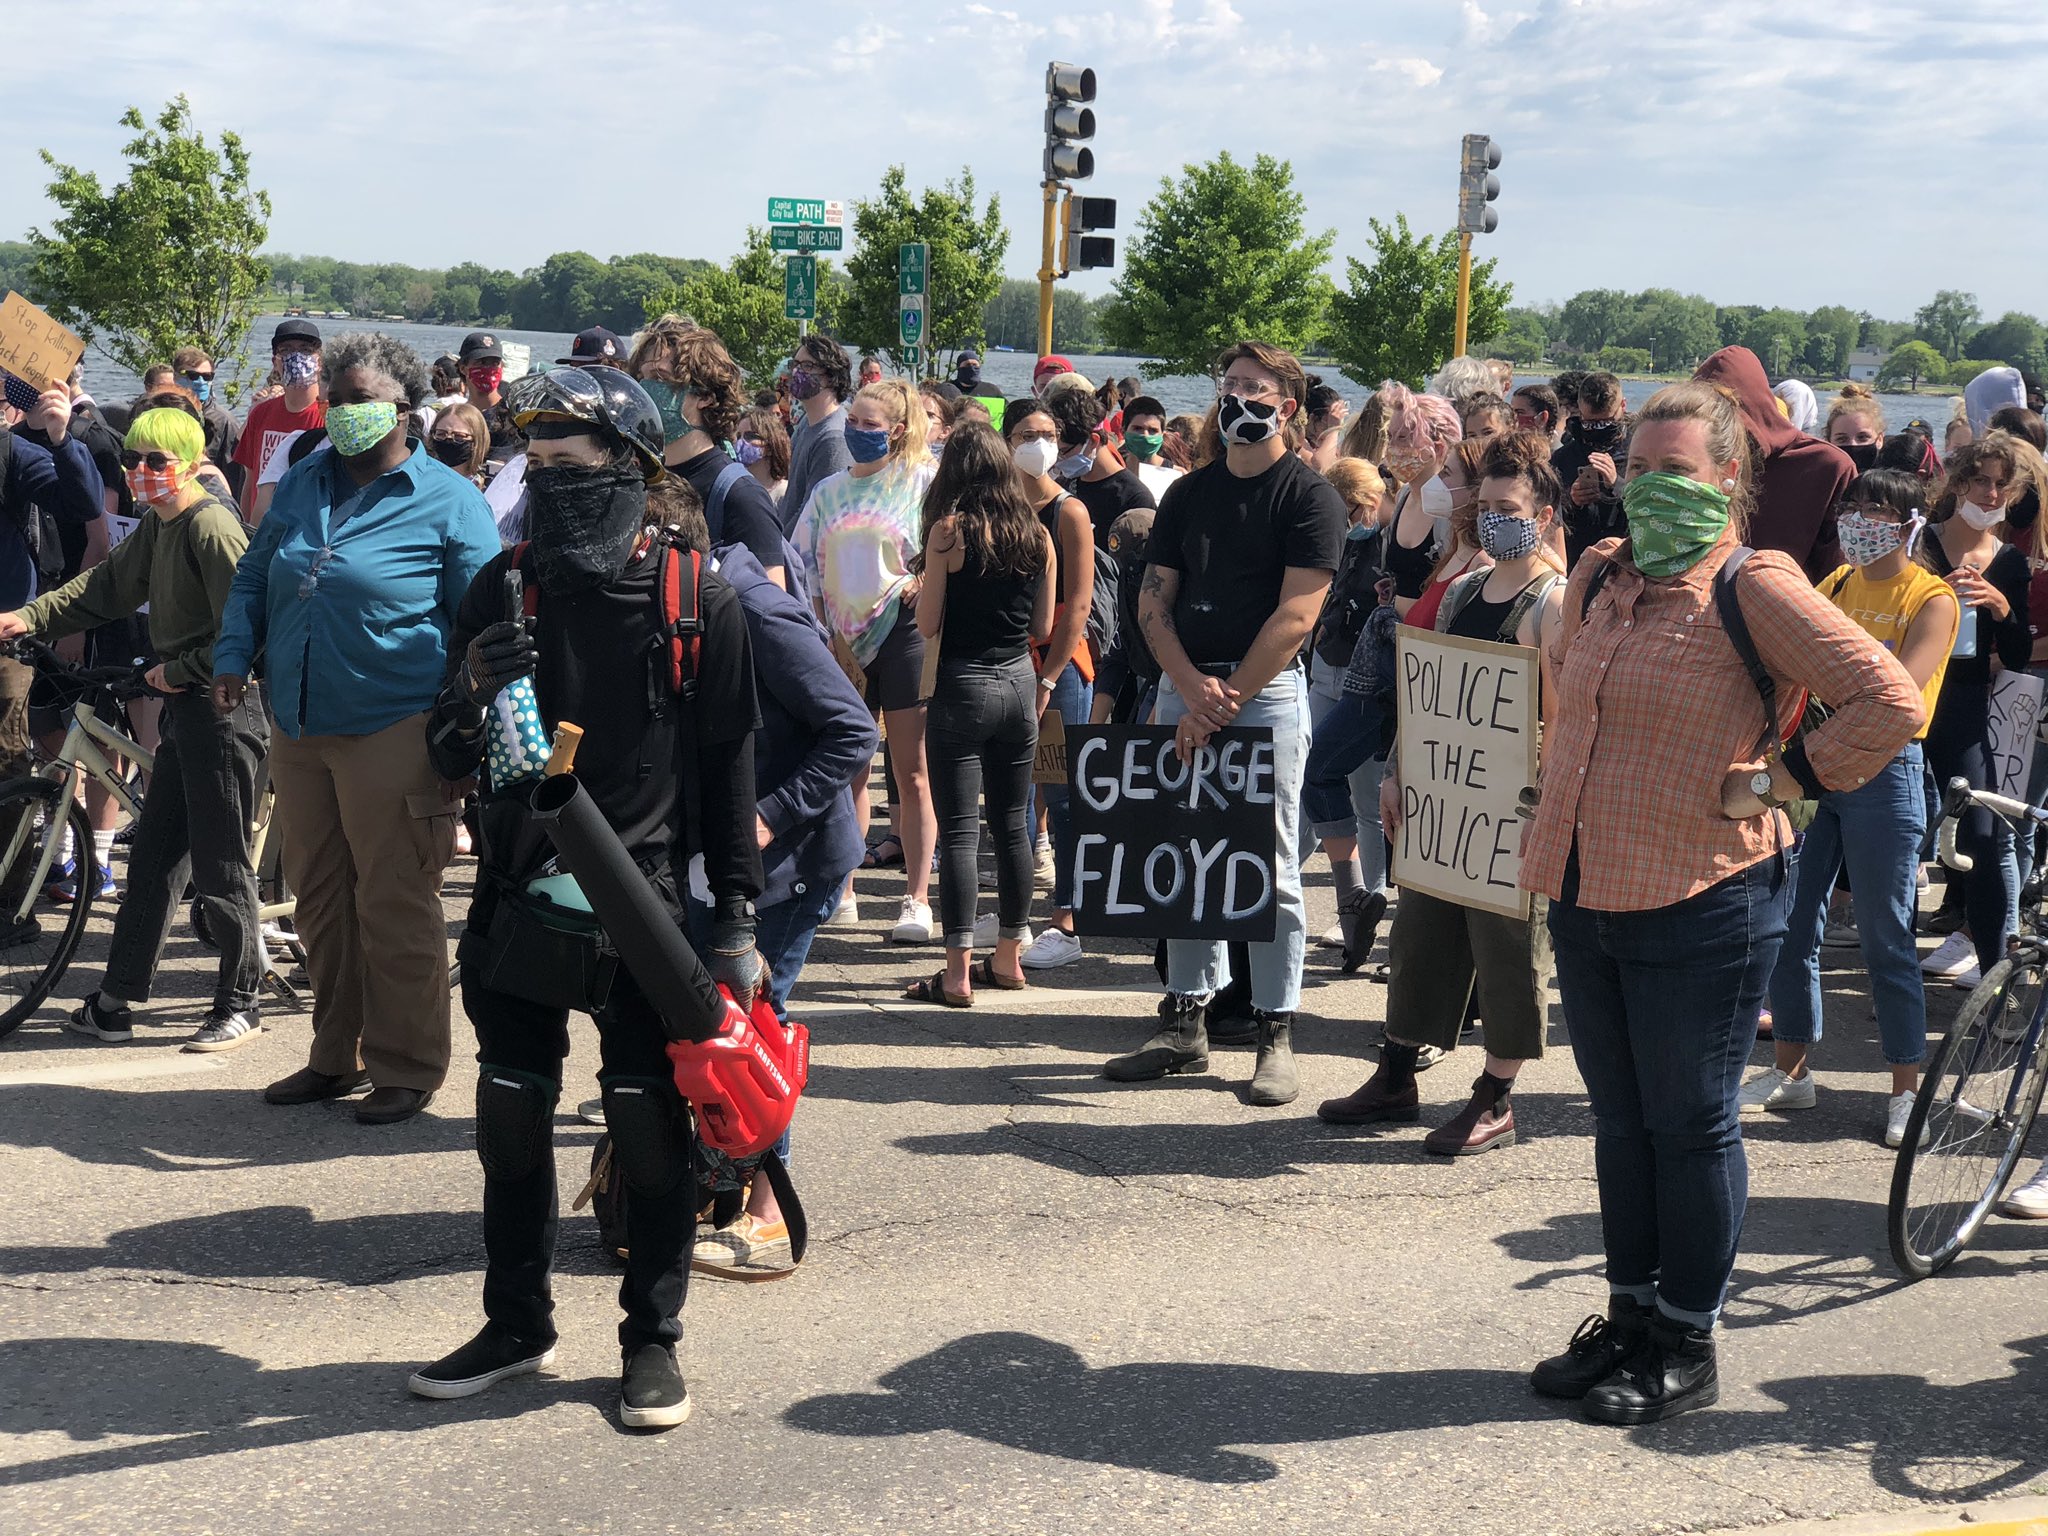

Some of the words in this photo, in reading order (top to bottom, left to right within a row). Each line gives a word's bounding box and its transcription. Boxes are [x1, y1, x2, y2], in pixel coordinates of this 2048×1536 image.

[796, 203, 822, 219] PATH
[797, 231, 816, 246] BIKE
[818, 231, 840, 246] PATH
[12, 305, 38, 335] Stop
[22, 351, 50, 385] People
[1404, 652, 1519, 733] POLICE
[1076, 737, 1274, 812] GEORGE
[1423, 740, 1487, 790] THE
[1404, 785, 1518, 888] POLICE
[1072, 834, 1271, 922] FLOYD
[754, 1043, 791, 1097] CRAFTSMAN
